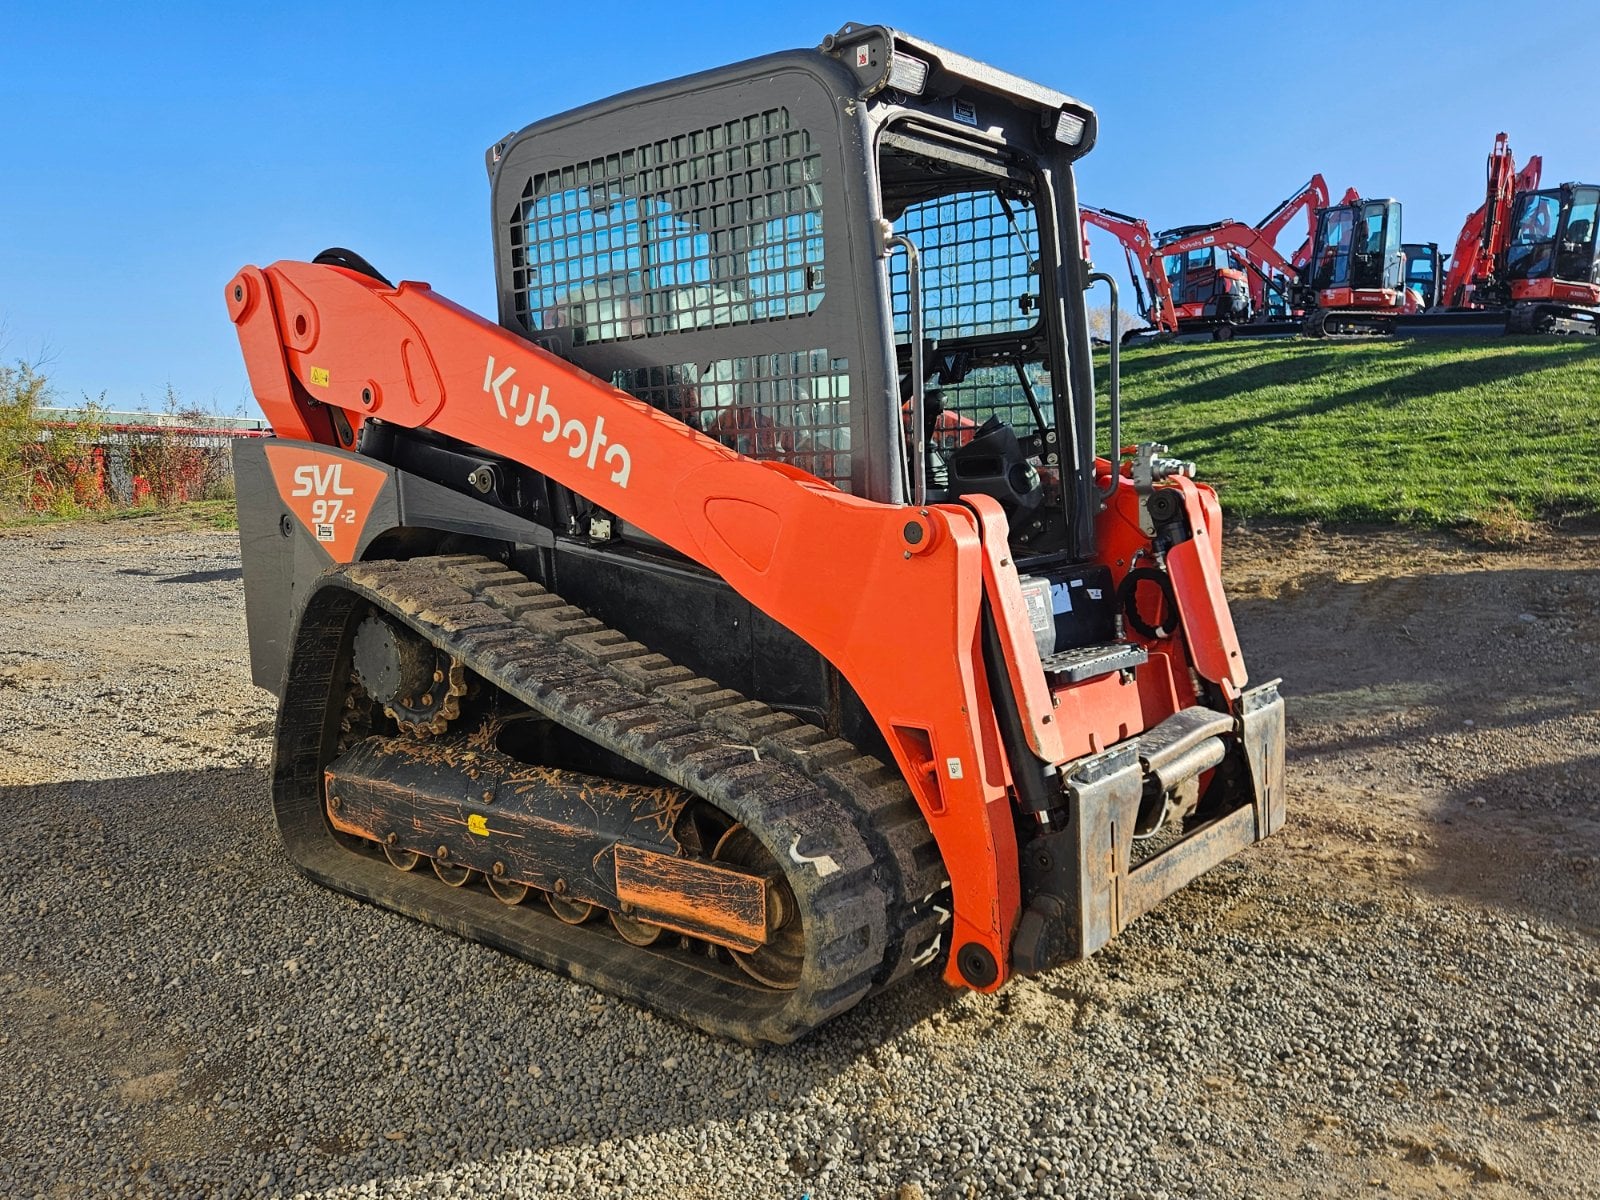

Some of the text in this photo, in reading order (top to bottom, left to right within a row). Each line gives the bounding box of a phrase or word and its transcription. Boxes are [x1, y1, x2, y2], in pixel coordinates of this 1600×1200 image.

[483, 355, 631, 489] Kubota
[292, 464, 354, 497] SVL
[312, 500, 356, 524] 97-2
